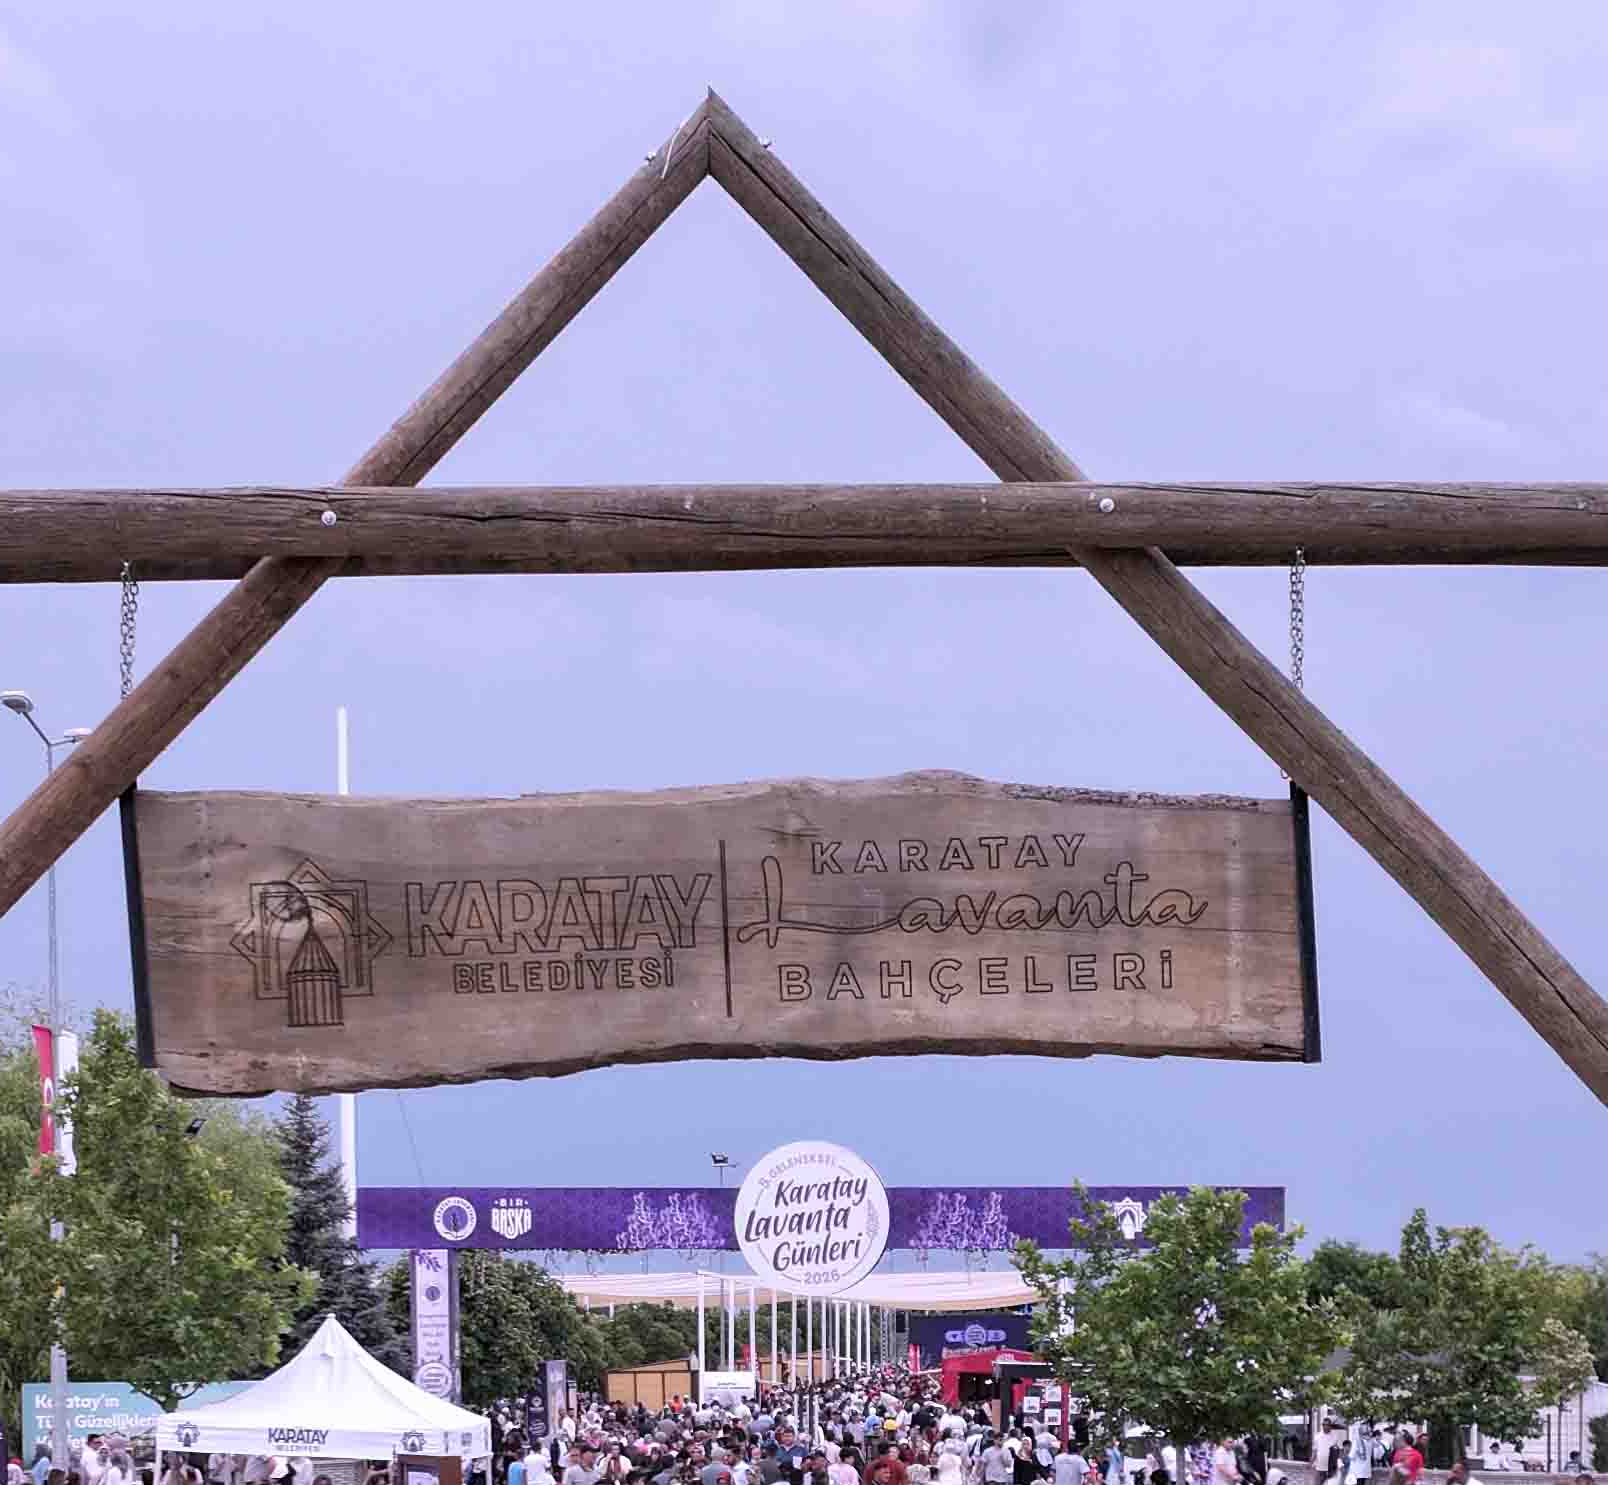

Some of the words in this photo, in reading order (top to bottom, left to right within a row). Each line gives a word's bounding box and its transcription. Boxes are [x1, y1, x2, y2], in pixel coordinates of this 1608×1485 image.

[810, 833, 1086, 875] KARATAY
[403, 873, 713, 958] KARATAY
[736, 855, 1209, 949] Lavanta
[453, 949, 675, 994] BELEDİYESİ
[774, 1175, 869, 1208] Karatay
[744, 1202, 852, 1243] Lavanta
[772, 1231, 863, 1272] Günleri
[267, 1427, 329, 1445] KARATAY
